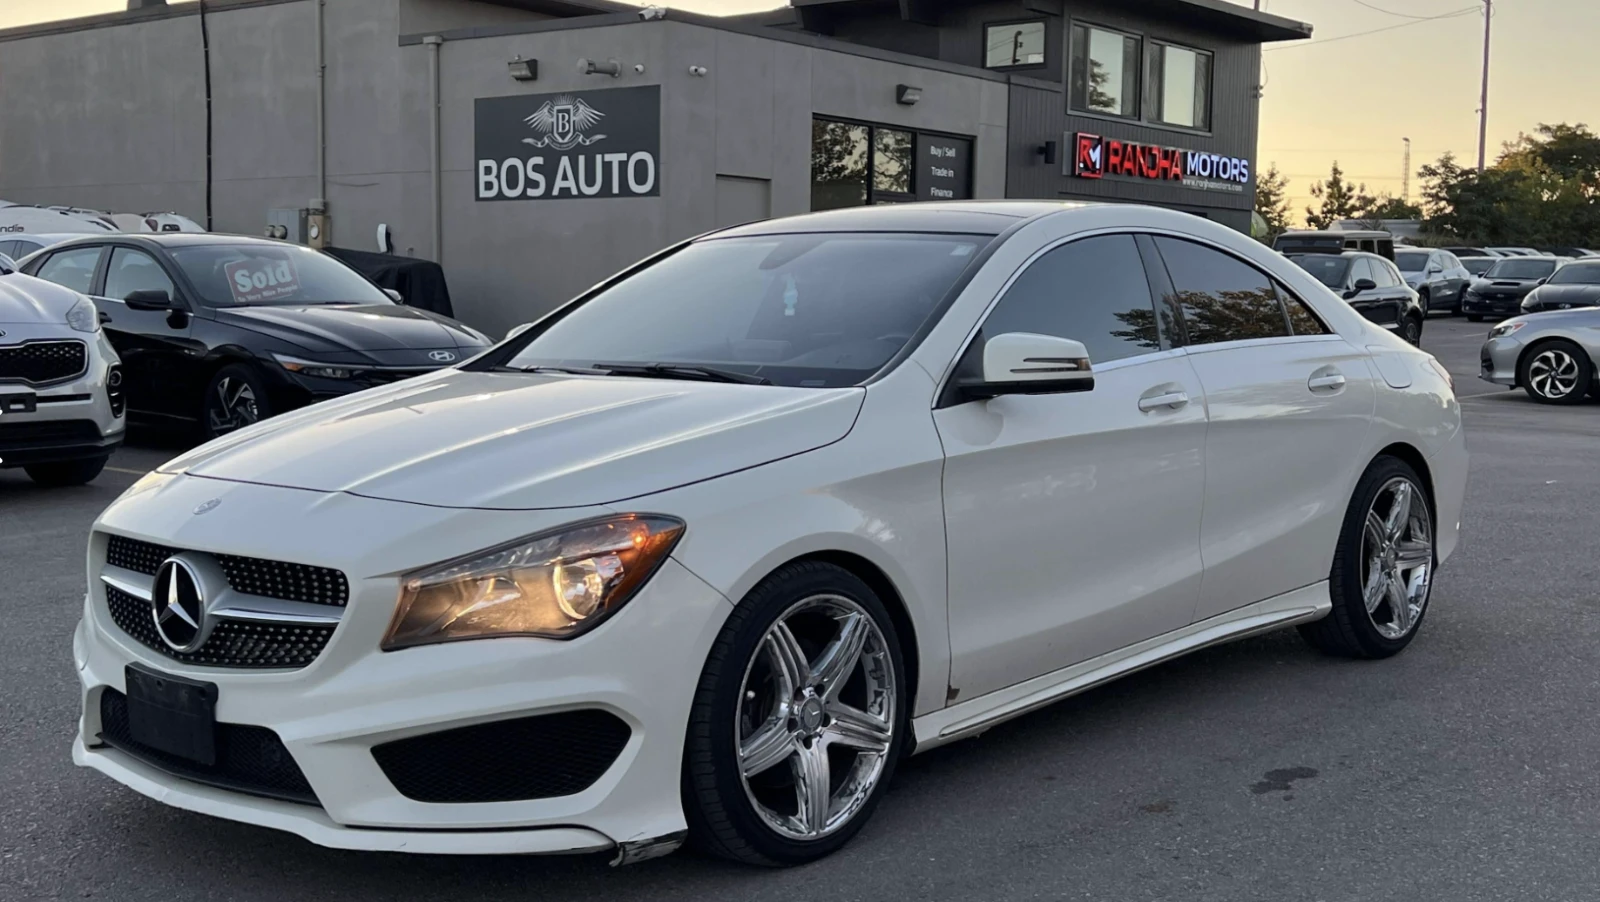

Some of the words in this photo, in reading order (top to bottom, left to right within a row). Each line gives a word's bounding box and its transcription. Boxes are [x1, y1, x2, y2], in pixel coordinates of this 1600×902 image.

[479, 156, 546, 198] BOS
[552, 151, 655, 196] AUTO
[931, 167, 947, 177] Trade
[948, 169, 954, 177] in
[1109, 141, 1182, 180] RANJHA
[1187, 153, 1248, 183] MOTORS
[930, 187, 953, 198] Finance
[234, 261, 292, 293] Sold
